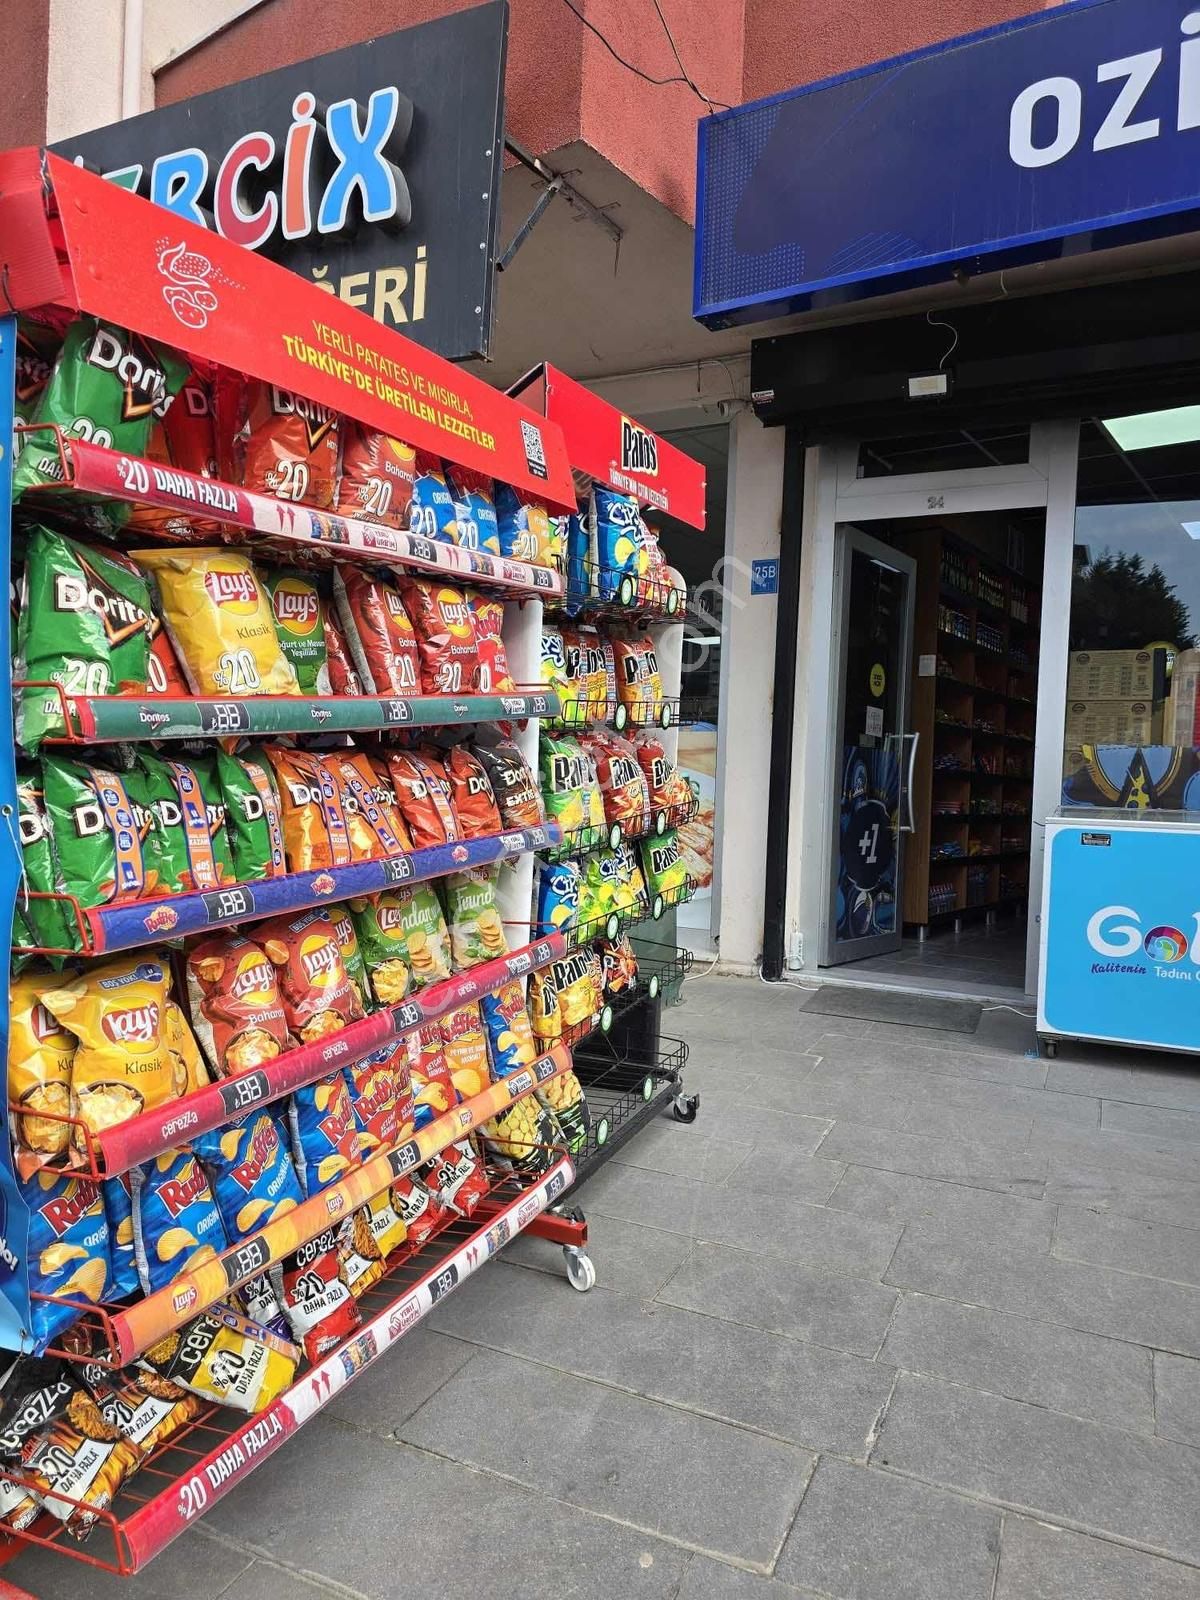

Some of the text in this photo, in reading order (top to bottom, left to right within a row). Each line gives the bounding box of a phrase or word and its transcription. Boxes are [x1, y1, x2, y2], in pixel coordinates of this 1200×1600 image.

[312, 320, 353, 358] YERLİ
[356, 344, 410, 386] PATATES
[411, 373, 426, 394] VE
[376, 377, 436, 426] ÜRETİLEN
[437, 411, 496, 451] LEZZETLER
[117, 457, 238, 513] %20 DAHA FAZLA
[211, 570, 255, 603] Lay's
[278, 590, 318, 621] Lay's
[235, 624, 273, 640] Klasik
[213, 647, 262, 695] %20
[303, 941, 339, 975] Lay's
[1091, 963, 1147, 975] Kalitenin
[1153, 966, 1192, 981] Tadını
[232, 962, 275, 997] Lay's
[125, 1059, 163, 1075] Klasik
[303, 1297, 327, 1315] DAHA
[326, 1287, 344, 1307] FAZLA
[250, 1345, 265, 1372] FAZLA
[81, 1450, 100, 1475] FAZLA
[206, 1446, 245, 1489] DAHA
[243, 1413, 282, 1457] FAZLA
